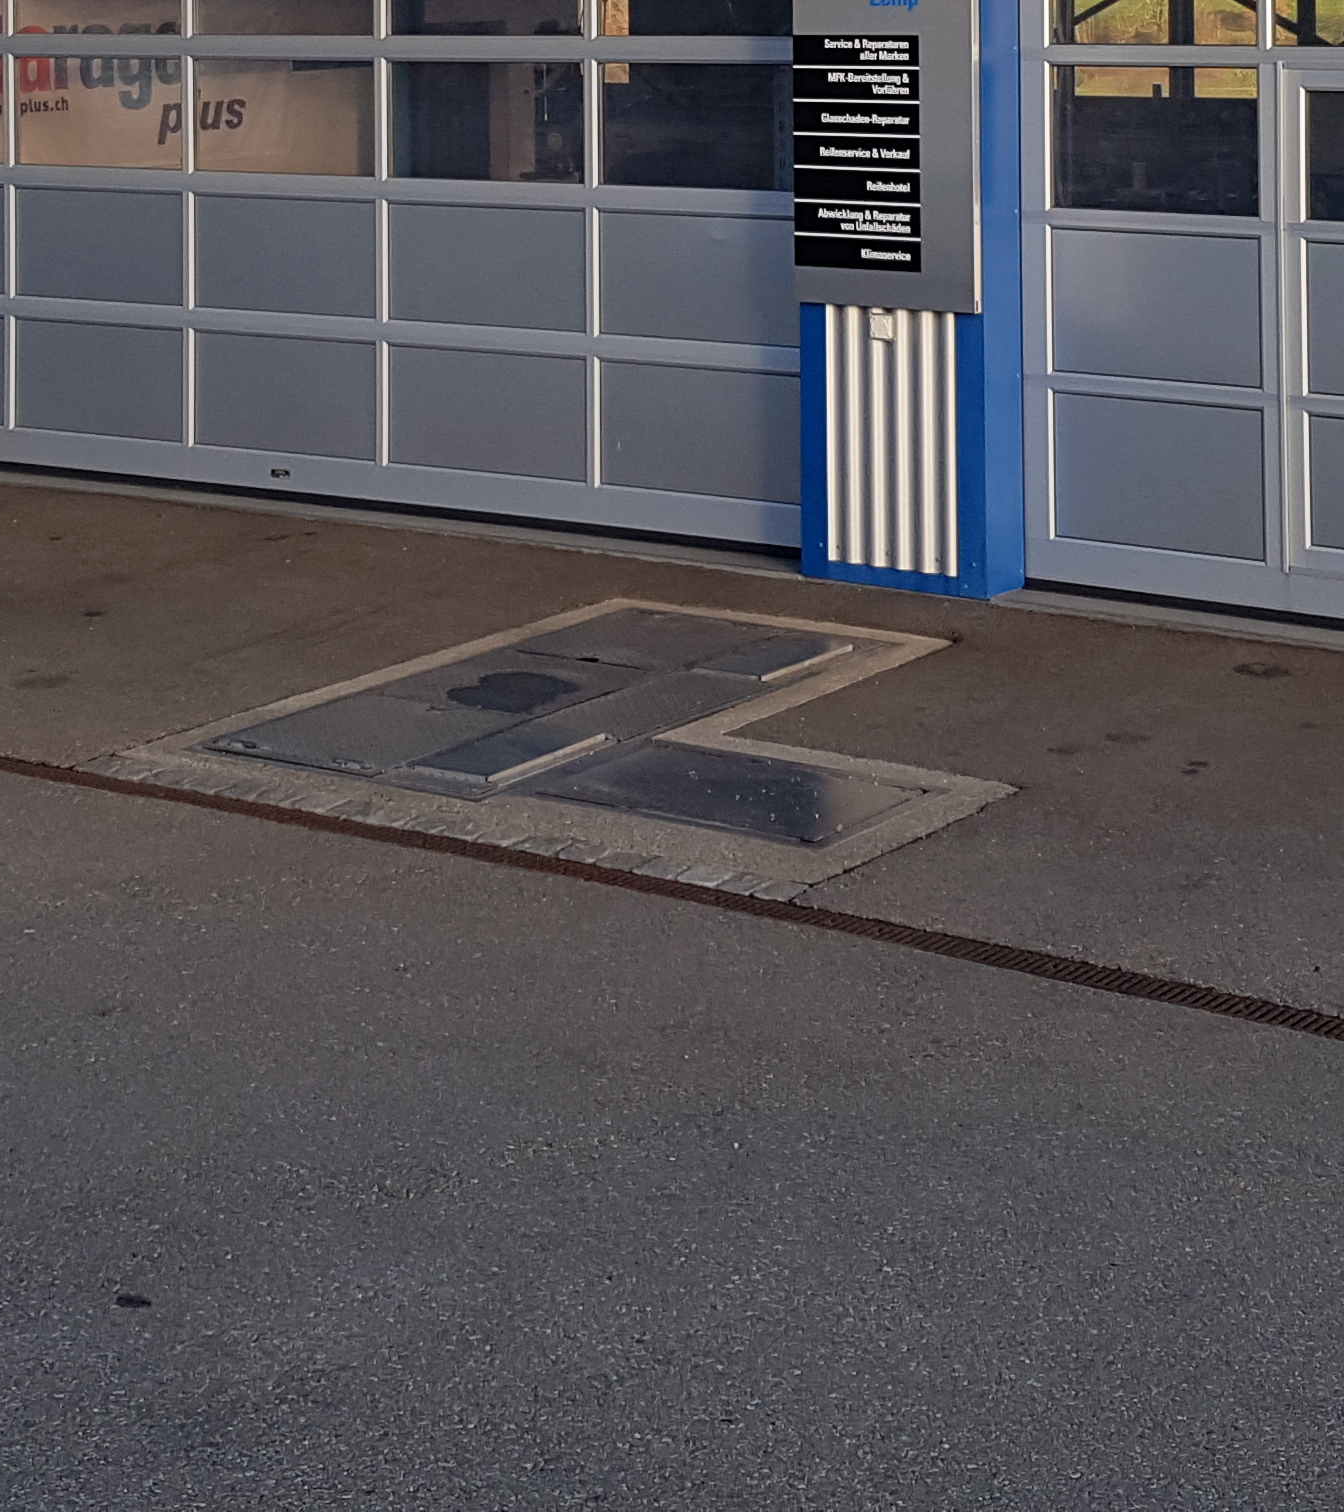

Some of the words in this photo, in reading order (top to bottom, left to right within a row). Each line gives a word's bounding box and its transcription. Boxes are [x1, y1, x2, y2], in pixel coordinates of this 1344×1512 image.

[824, 38, 853, 49] Service
[854, 39, 861, 49] &
[902, 73, 909, 83] &
[157, 89, 247, 145] pus
[872, 148, 879, 158] &
[864, 209, 872, 220] &
